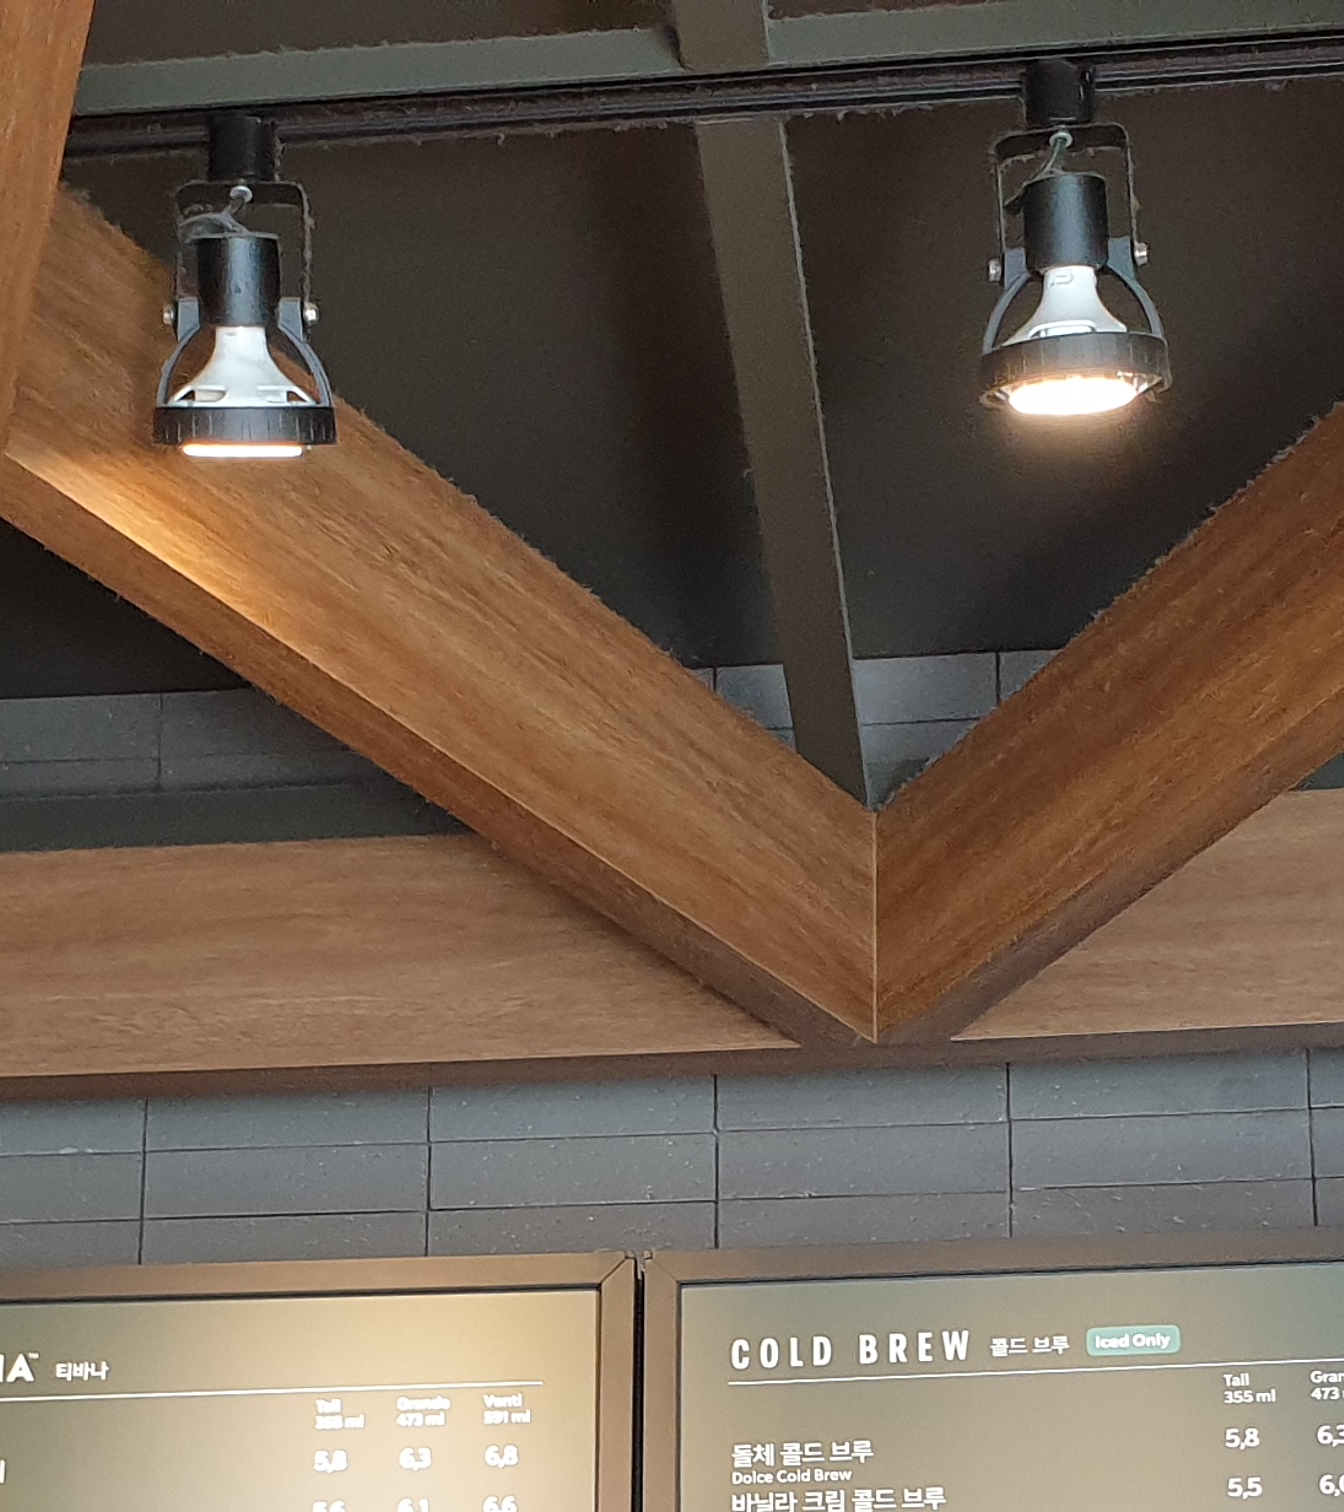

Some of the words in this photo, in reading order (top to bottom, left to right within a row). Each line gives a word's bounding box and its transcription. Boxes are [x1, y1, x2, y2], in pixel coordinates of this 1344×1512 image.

[731, 1336, 832, 1370] COLD
[859, 1330, 969, 1365] BREW
[990, 1337, 1028, 1357] 콜드
[1032, 1335, 1070, 1355] 브루
[1094, 1334, 1127, 1350] Iced
[1132, 1332, 1170, 1351] Only
[55, 1360, 110, 1382] 티바나
[1223, 1373, 1249, 1386] Tall
[1224, 1389, 1254, 1404] 355
[1255, 1388, 1276, 1403] ml
[1310, 1386, 1340, 1400] 473
[851, 1489, 898, 1512] 콜드
[901, 1486, 947, 1511] 브루
[1227, 1477, 1263, 1500] 5,5
